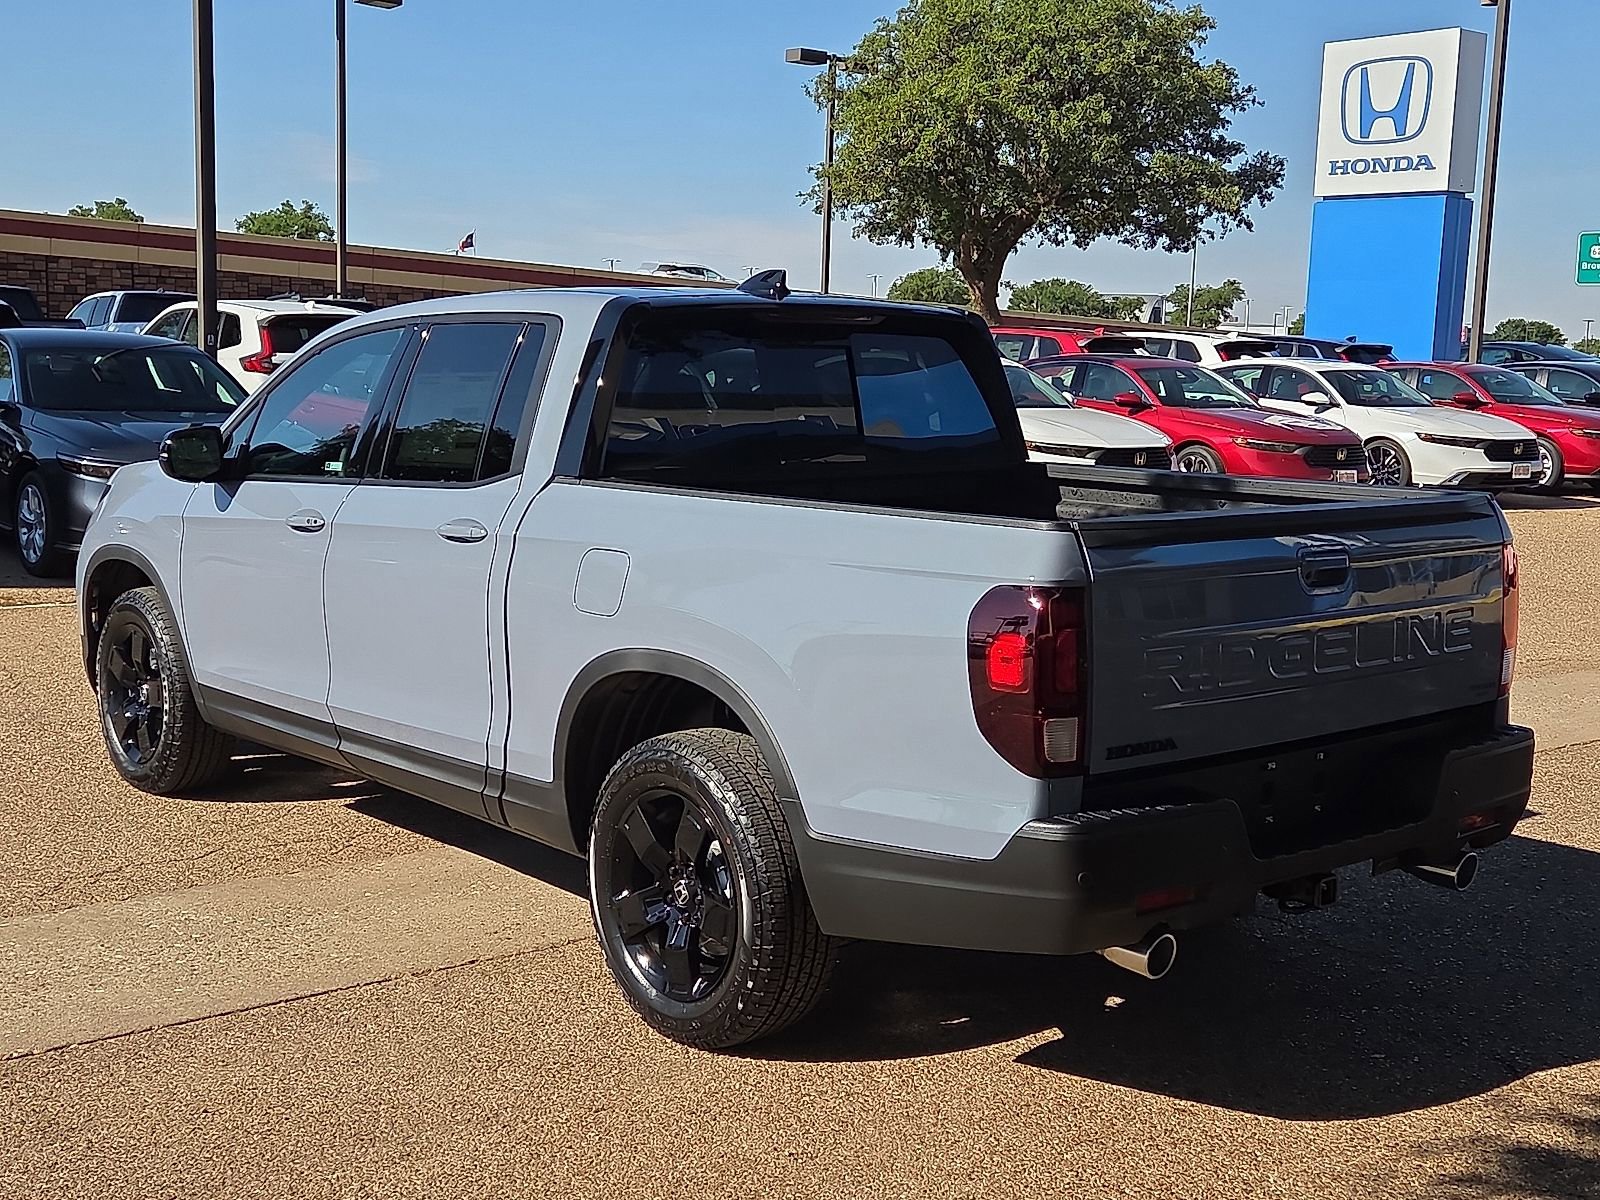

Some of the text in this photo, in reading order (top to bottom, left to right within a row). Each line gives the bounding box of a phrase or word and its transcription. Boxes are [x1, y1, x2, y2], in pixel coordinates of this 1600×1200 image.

[1328, 154, 1436, 176] HONDA
[1143, 606, 1474, 697] RIDGELINE
[1105, 737, 1178, 761] HONDA
